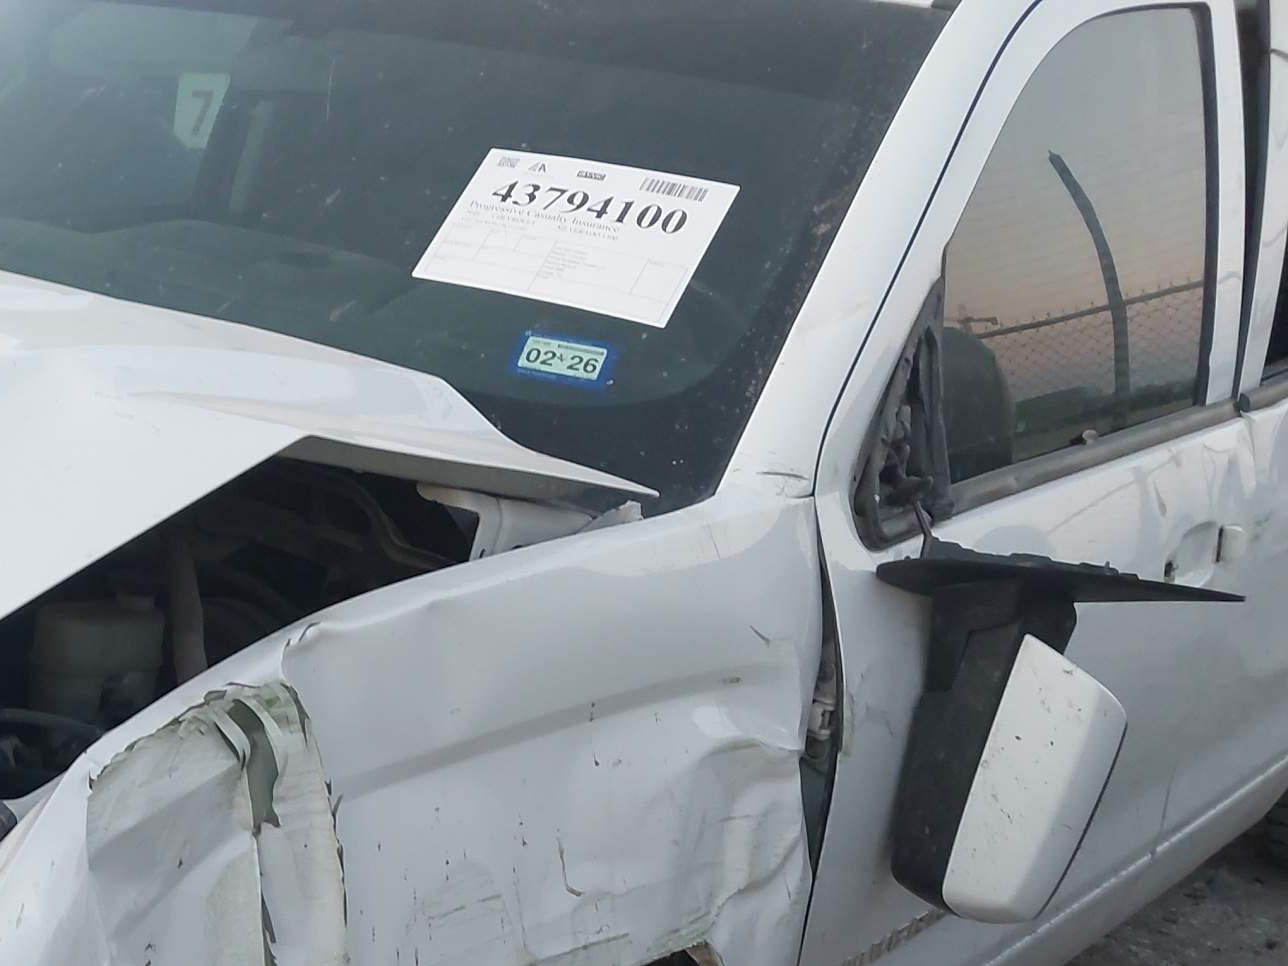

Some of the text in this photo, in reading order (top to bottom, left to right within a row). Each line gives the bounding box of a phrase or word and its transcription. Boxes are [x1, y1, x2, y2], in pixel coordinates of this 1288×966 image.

[192, 89, 216, 136] 7
[492, 180, 688, 234] 43794100
[572, 217, 620, 232] Insurance
[525, 347, 557, 367] 02
[566, 355, 599, 374] 26
